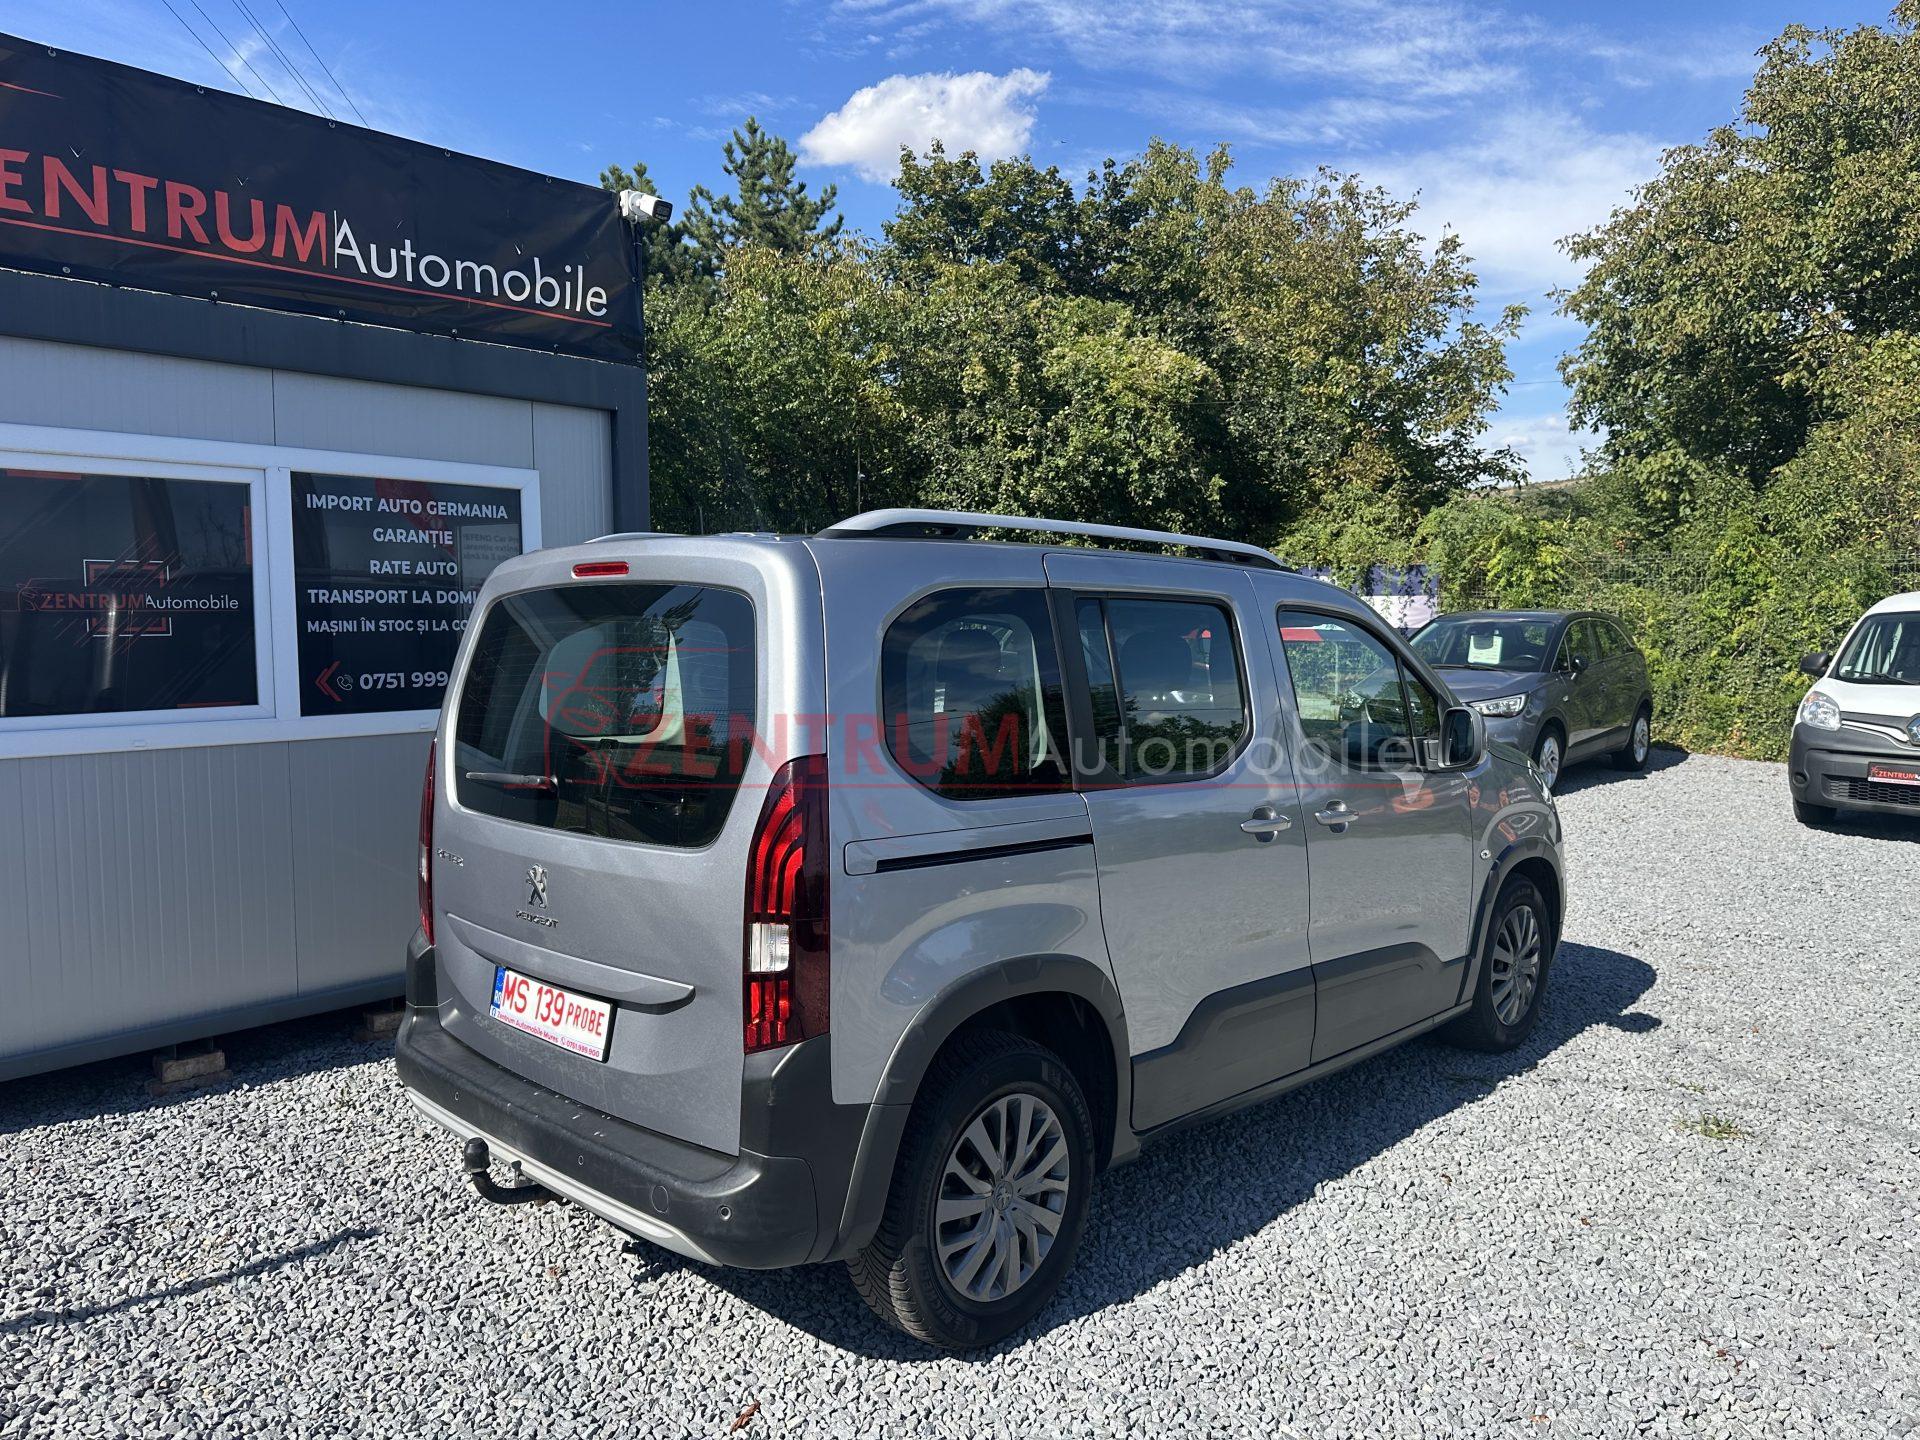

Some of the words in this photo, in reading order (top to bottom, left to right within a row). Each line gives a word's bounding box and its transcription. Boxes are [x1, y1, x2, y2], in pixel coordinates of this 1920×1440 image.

[335, 217, 608, 317] Automobile
[306, 493, 373, 512] IMPORT
[377, 498, 422, 515] AUTO
[426, 500, 508, 520] GERMANIA
[372, 527, 453, 548] GARANȚIE
[370, 559, 411, 575] RATE
[415, 560, 458, 576] AUTO
[41, 593, 145, 610] ZENTRUM
[145, 593, 239, 610] Automobile
[307, 589, 408, 604] TRANSPORT
[412, 590, 433, 604] LA
[307, 620, 358, 637] MAȘINI
[359, 617, 376, 632] ÎN
[378, 619, 414, 632] STOC
[417, 619, 429, 636] ȘI
[432, 619, 449, 631] LA
[359, 672, 405, 690] 0751
[411, 671, 449, 688] 999
[502, 973, 530, 1014] MS
[534, 986, 566, 1027] 139
[565, 1002, 605, 1037] PROBE
